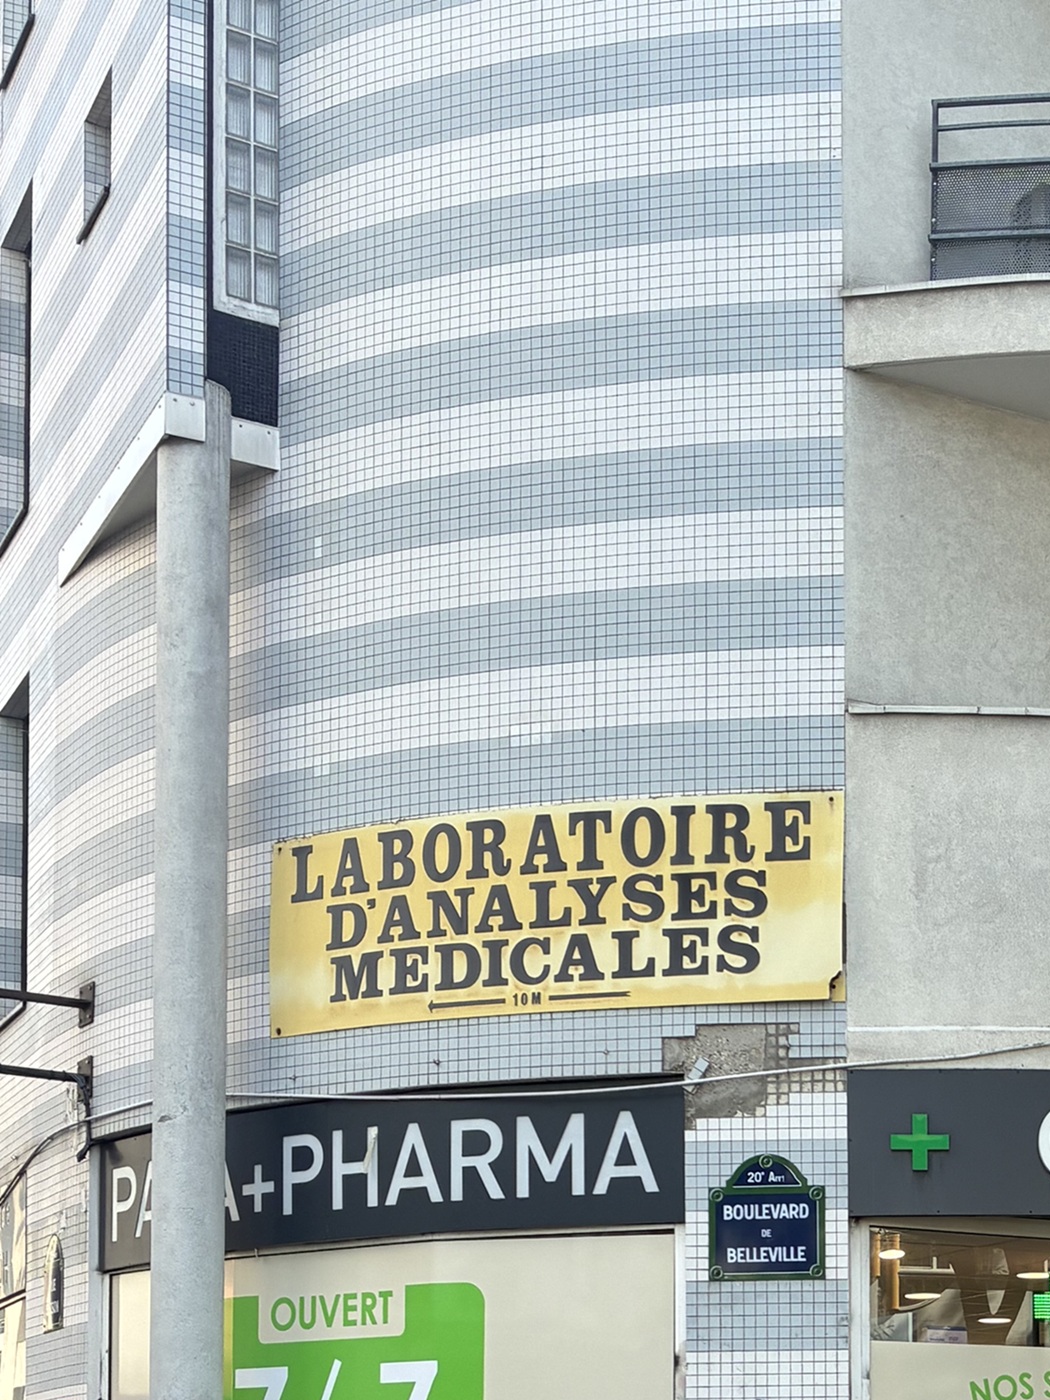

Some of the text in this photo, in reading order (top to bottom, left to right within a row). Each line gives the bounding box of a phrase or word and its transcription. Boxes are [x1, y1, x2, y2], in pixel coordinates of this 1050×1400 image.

[291, 801, 811, 904] LABORATOIRE
[326, 869, 768, 951] D'ANALYSES
[330, 924, 761, 1003] MEDICALES
[723, 1203, 810, 1221] BOULEVARD
[726, 1246, 807, 1263] BELLEVILLE
[761, 1229, 772, 1238] DE
[270, 1290, 394, 1332] OUVERT
